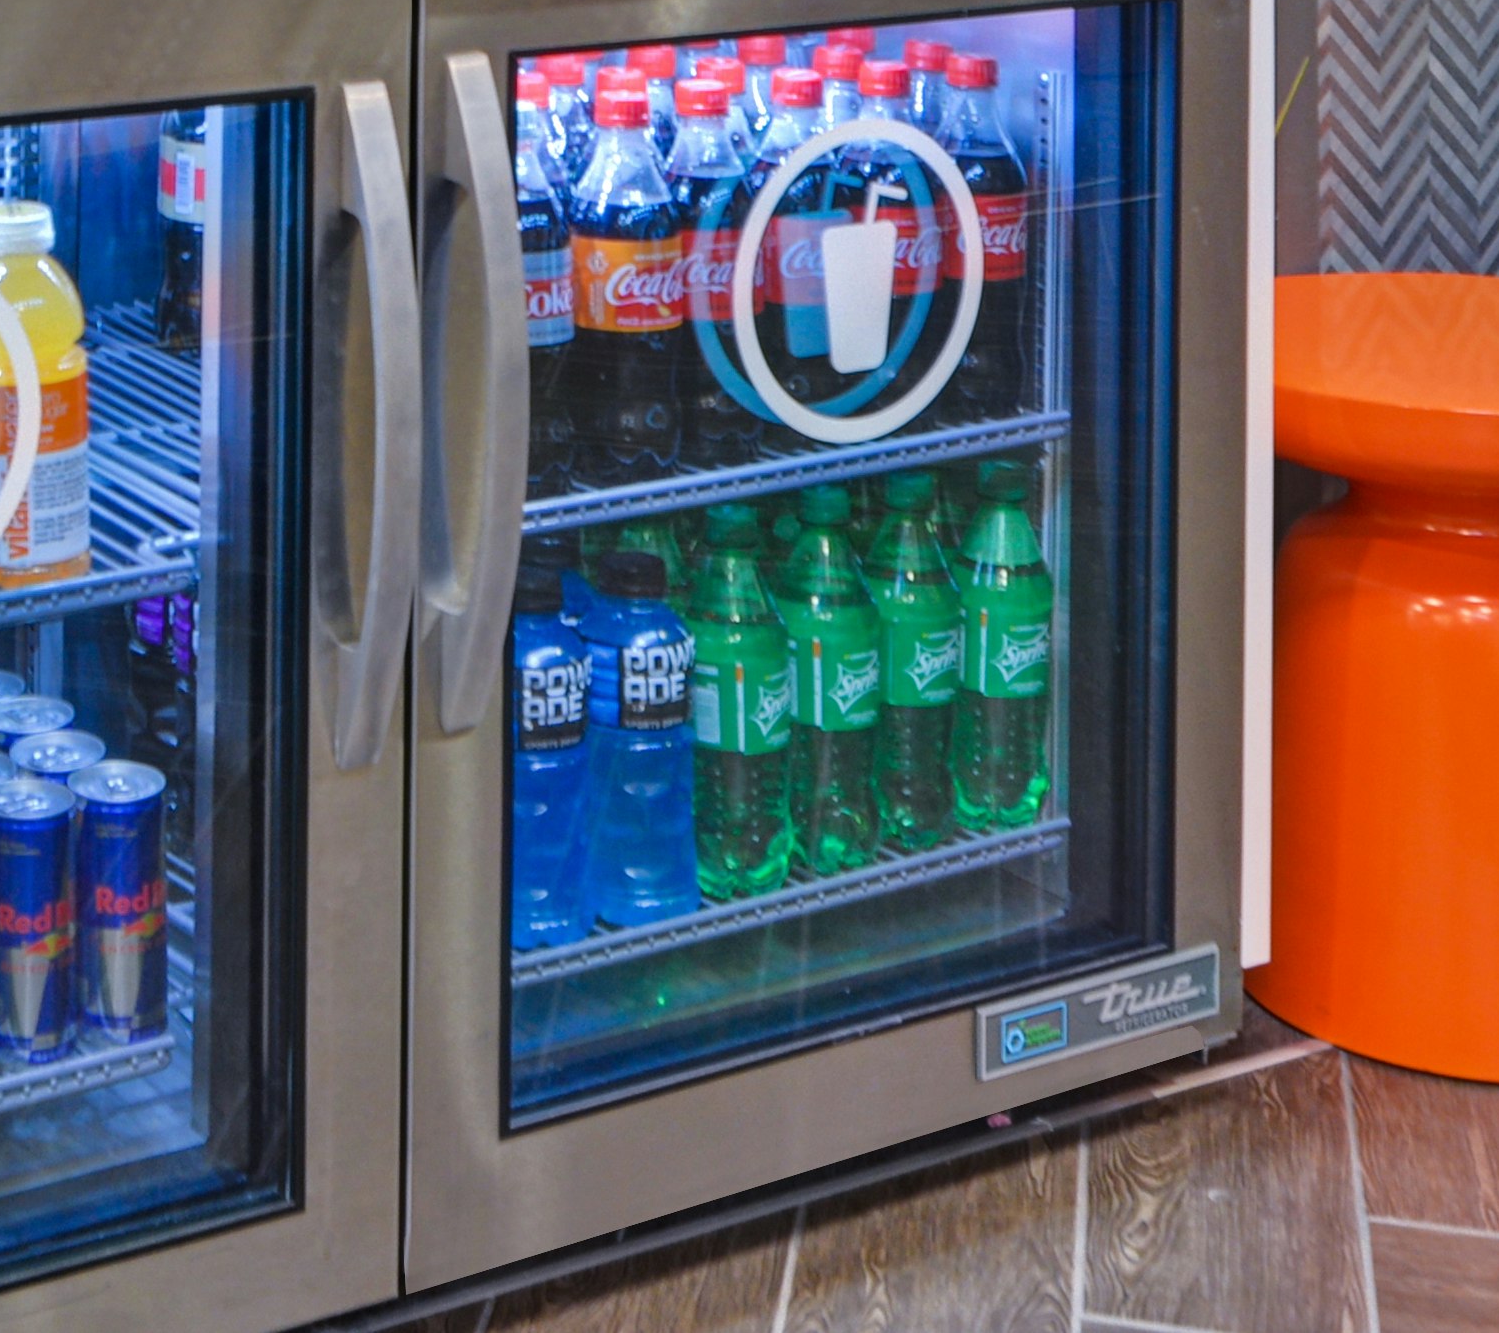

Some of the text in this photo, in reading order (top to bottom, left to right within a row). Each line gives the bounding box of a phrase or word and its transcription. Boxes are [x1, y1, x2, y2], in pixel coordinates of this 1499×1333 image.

[524, 281, 573, 318] oke
[623, 672, 686, 705] ADE
[521, 691, 584, 730] ADE
[95, 882, 150, 915] Red
